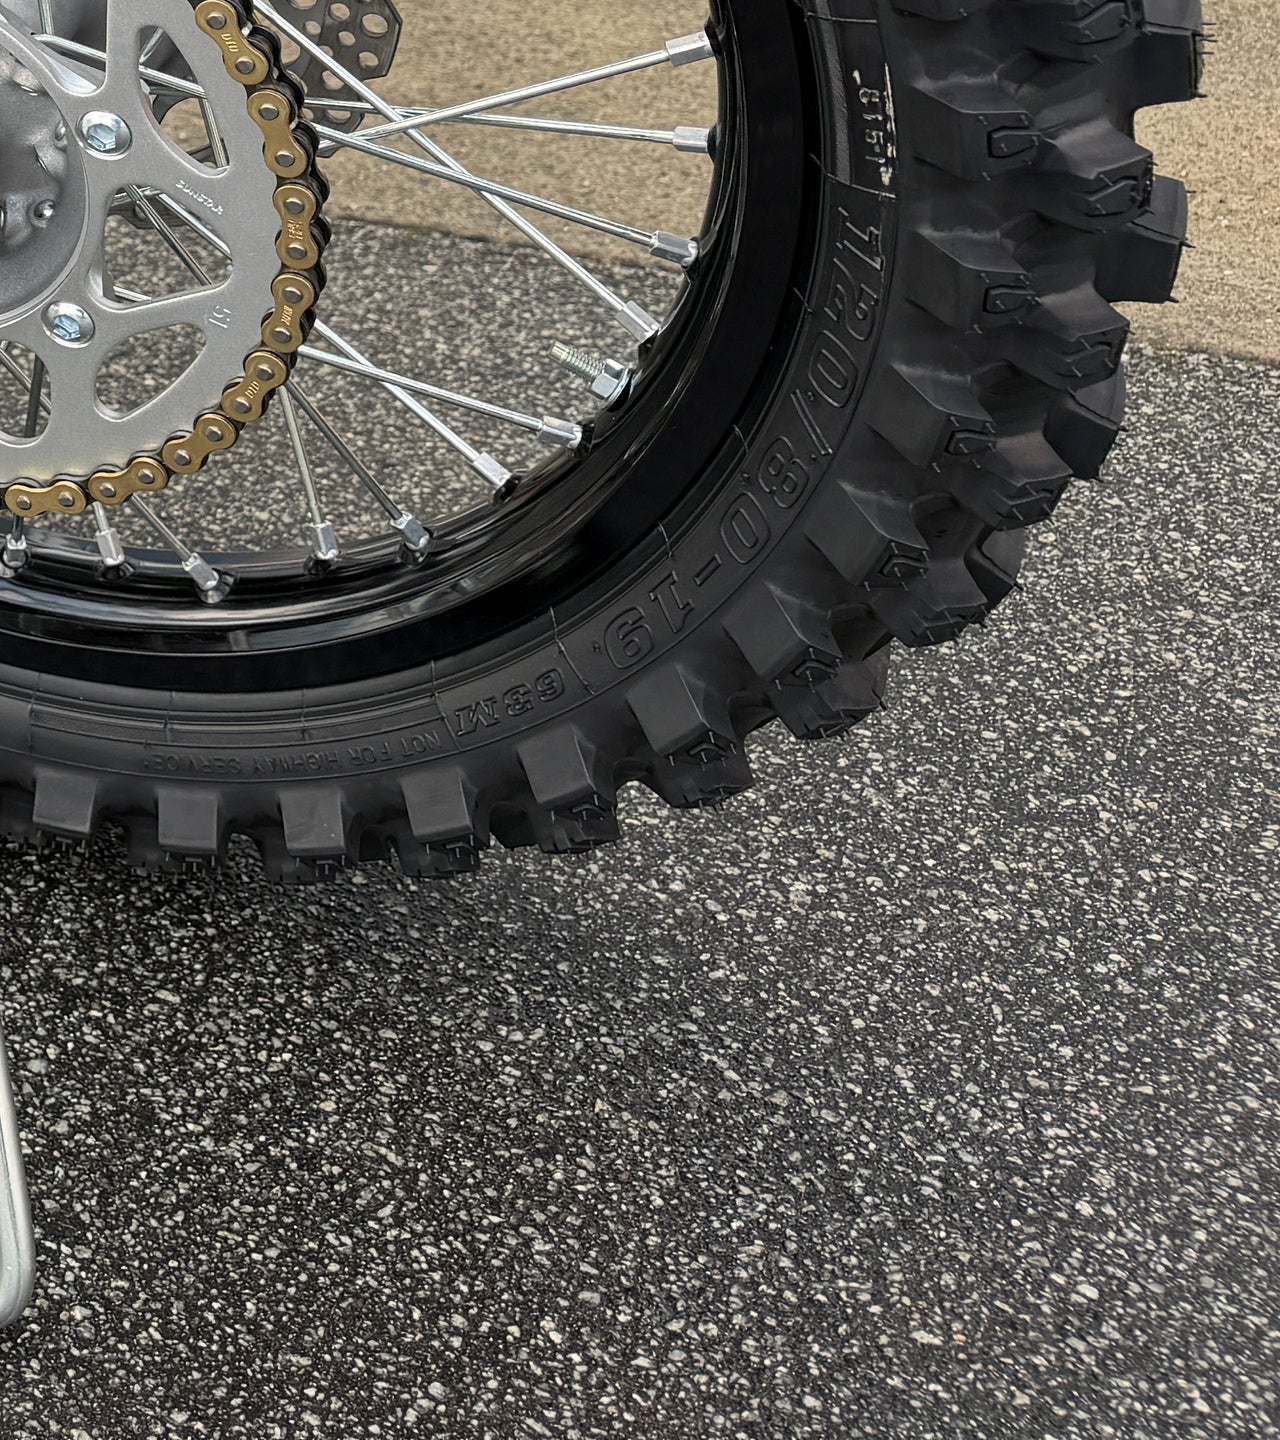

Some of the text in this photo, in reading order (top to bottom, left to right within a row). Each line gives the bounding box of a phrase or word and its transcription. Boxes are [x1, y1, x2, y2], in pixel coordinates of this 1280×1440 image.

[601, 204, 886, 669] 120/80-19
[347, 740, 391, 766] FOR
[400, 729, 441, 760] NOT
